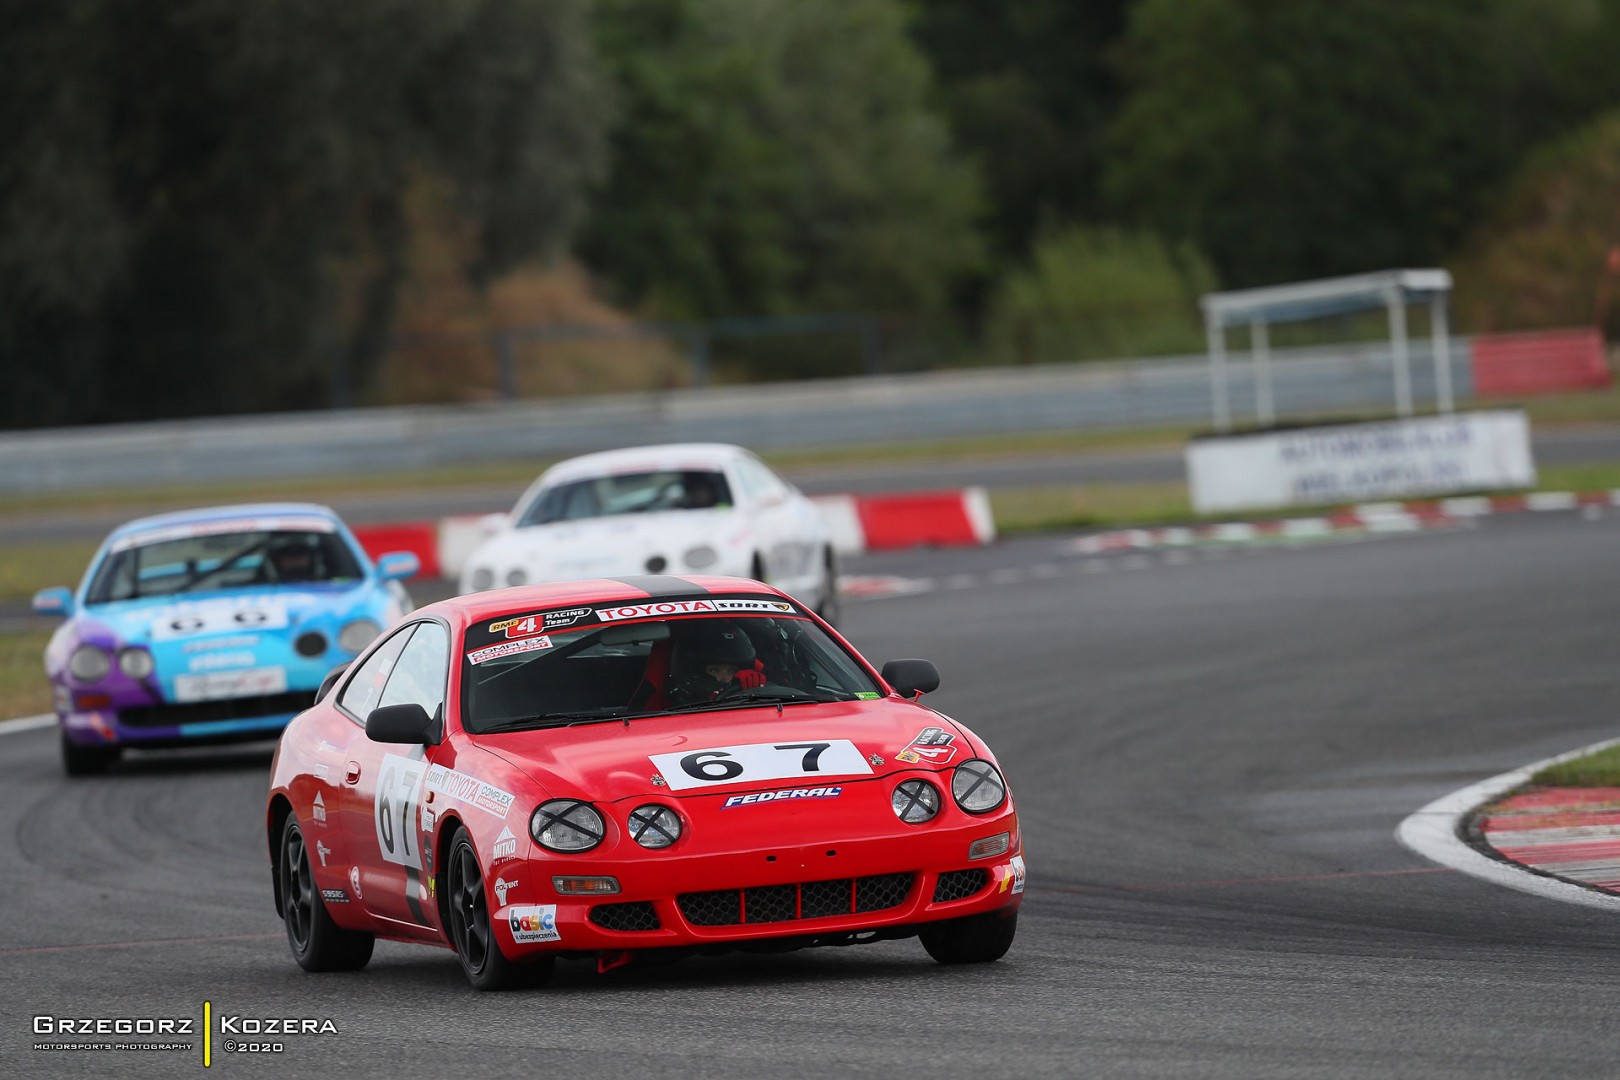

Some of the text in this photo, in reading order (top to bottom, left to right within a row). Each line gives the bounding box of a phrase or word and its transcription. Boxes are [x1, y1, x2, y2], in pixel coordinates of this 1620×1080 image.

[545, 609, 585, 619] RACING
[600, 601, 712, 620] TOYOTA
[493, 620, 518, 631] RMF
[517, 618, 537, 632] 4
[545, 617, 570, 626] Team
[472, 637, 547, 658] COMPLEX
[475, 642, 548, 662] MOTORSPORT
[446, 773, 480, 802] TOYOTA
[481, 786, 513, 806] COMPLEX
[724, 786, 843, 808] FEDERAL
[379, 766, 419, 857] 67
[493, 839, 516, 859] MITKO
[510, 907, 553, 932] basic
